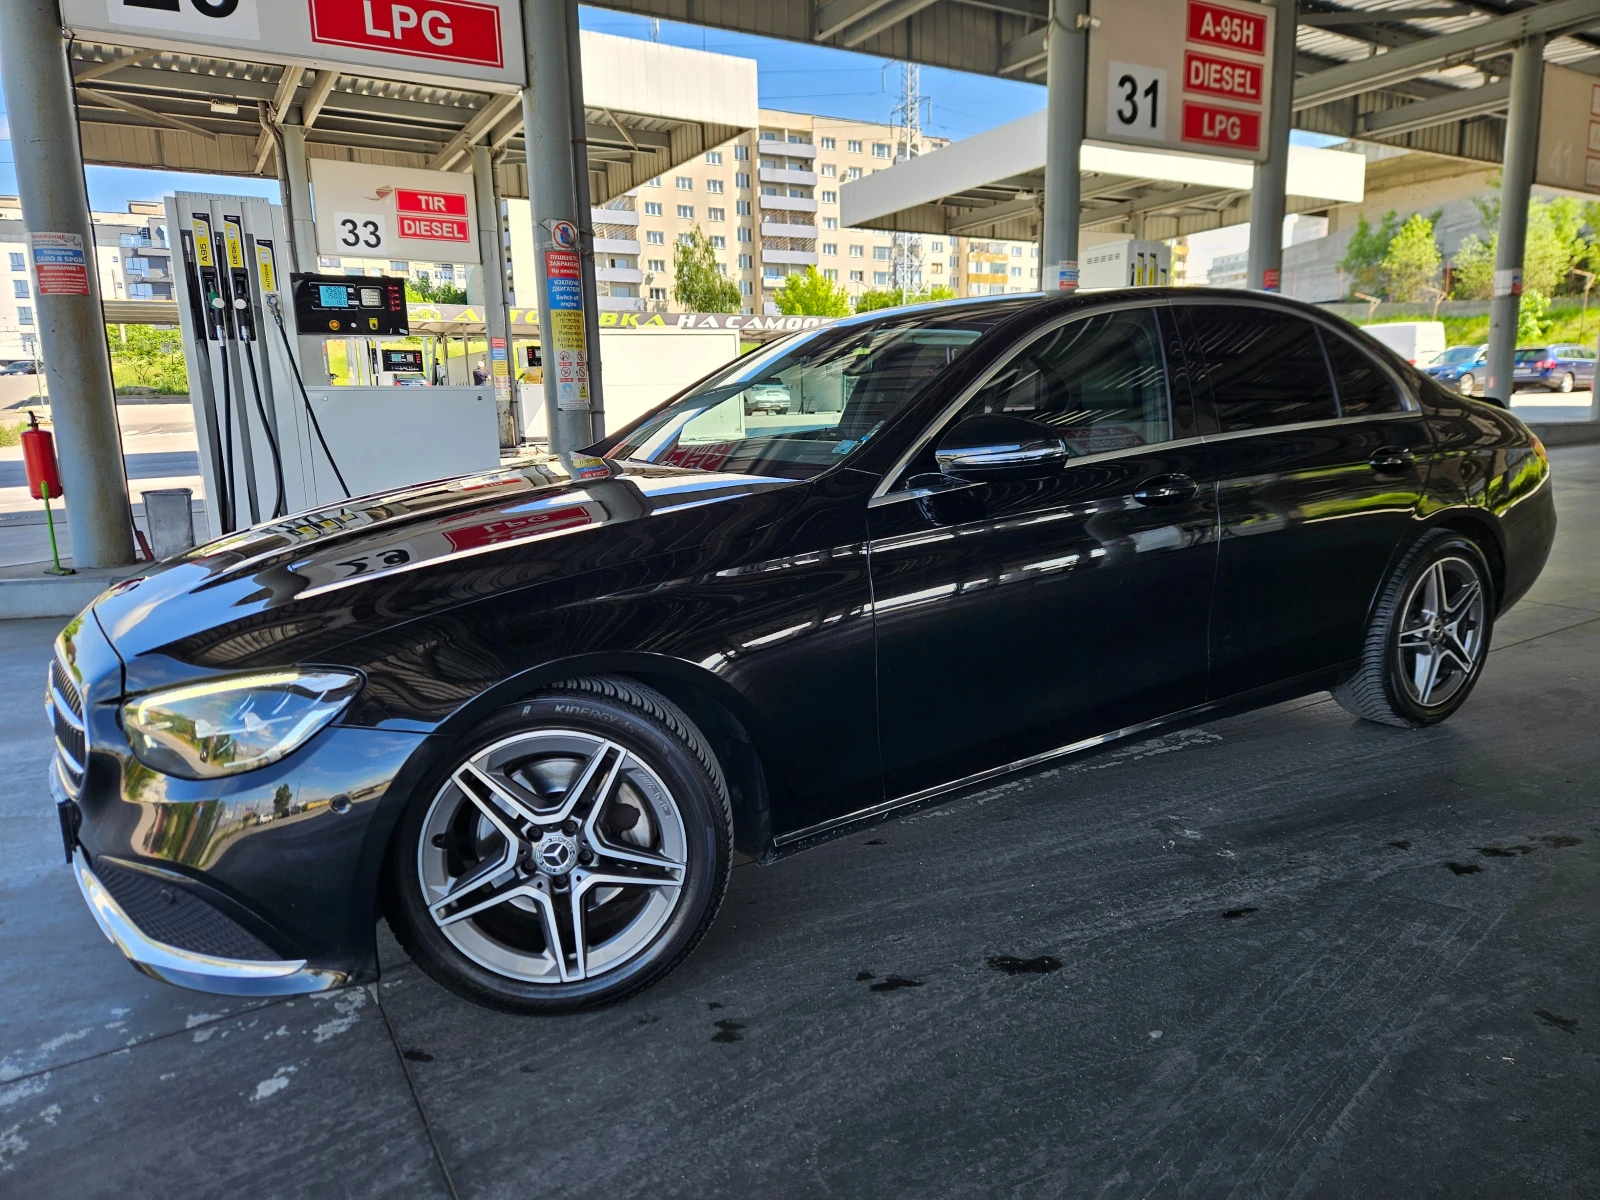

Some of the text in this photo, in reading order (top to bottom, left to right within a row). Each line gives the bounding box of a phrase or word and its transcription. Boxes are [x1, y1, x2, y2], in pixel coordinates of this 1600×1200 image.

[362, 0, 454, 47] LPG
[1189, 60, 1257, 96] DIESEL
[1117, 74, 1159, 129] 31
[1202, 112, 1241, 141] LPG
[417, 194, 447, 212] TIR
[340, 218, 382, 249] 33
[403, 219, 464, 239] DIESEL
[200, 243, 208, 262] A95
[560, 268, 579, 276] smoking
[676, 314, 720, 328] НА
[555, 704, 619, 723] KINERGY
